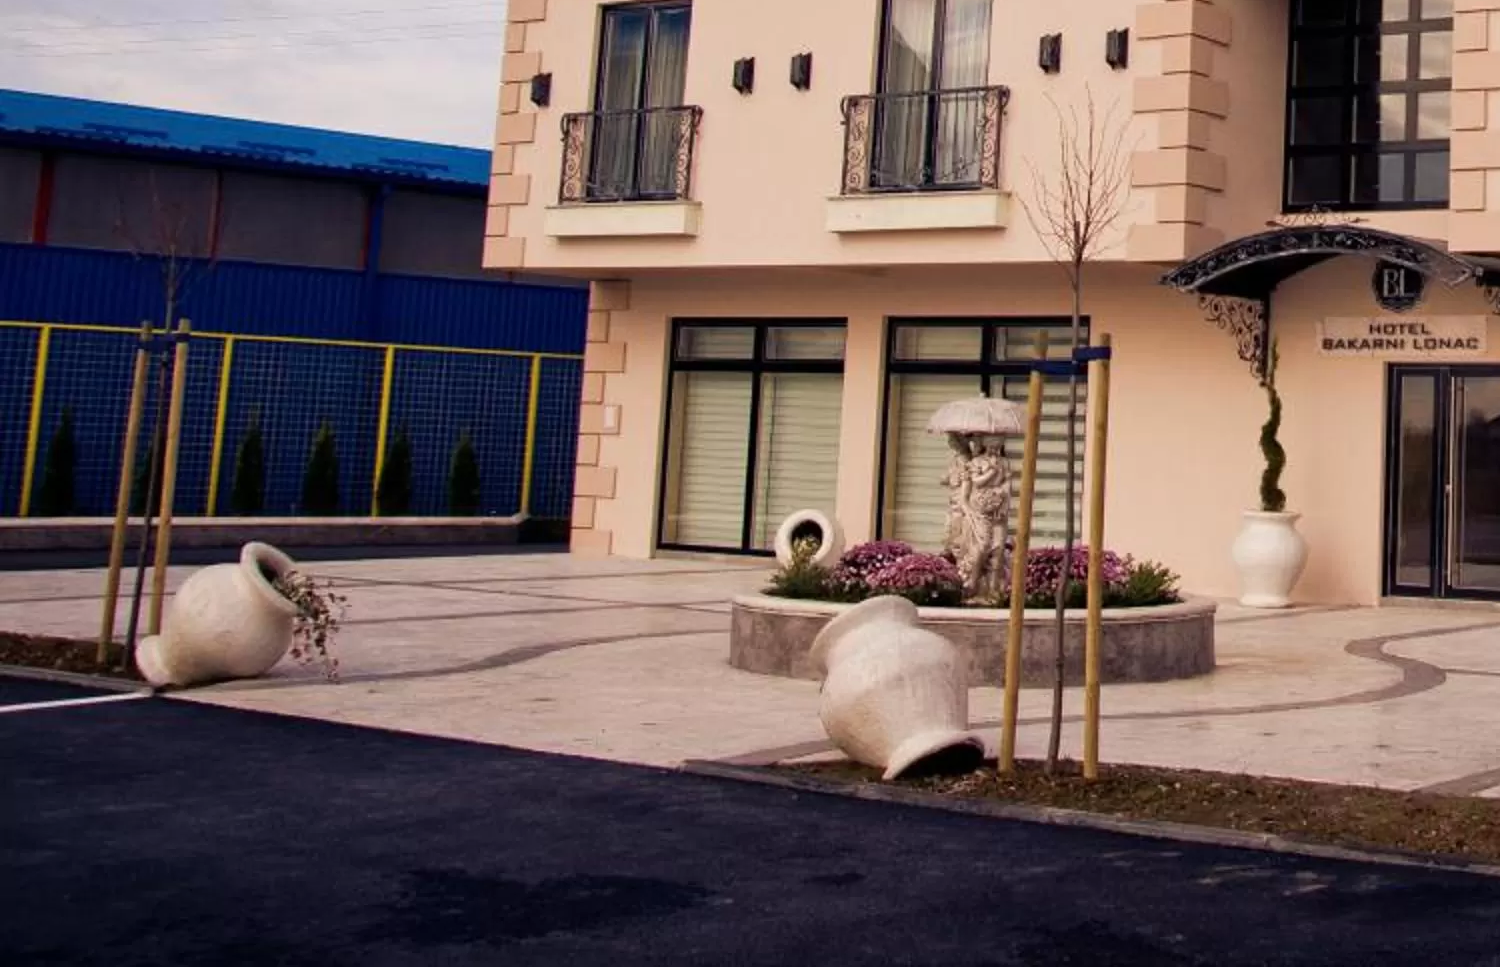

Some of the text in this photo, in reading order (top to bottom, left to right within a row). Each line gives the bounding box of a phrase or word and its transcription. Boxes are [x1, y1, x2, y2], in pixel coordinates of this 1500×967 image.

[1384, 268, 1414, 298] BL
[1369, 322, 1431, 335] HOTEL
[1322, 337, 1479, 351] BAKARNI LONAC
